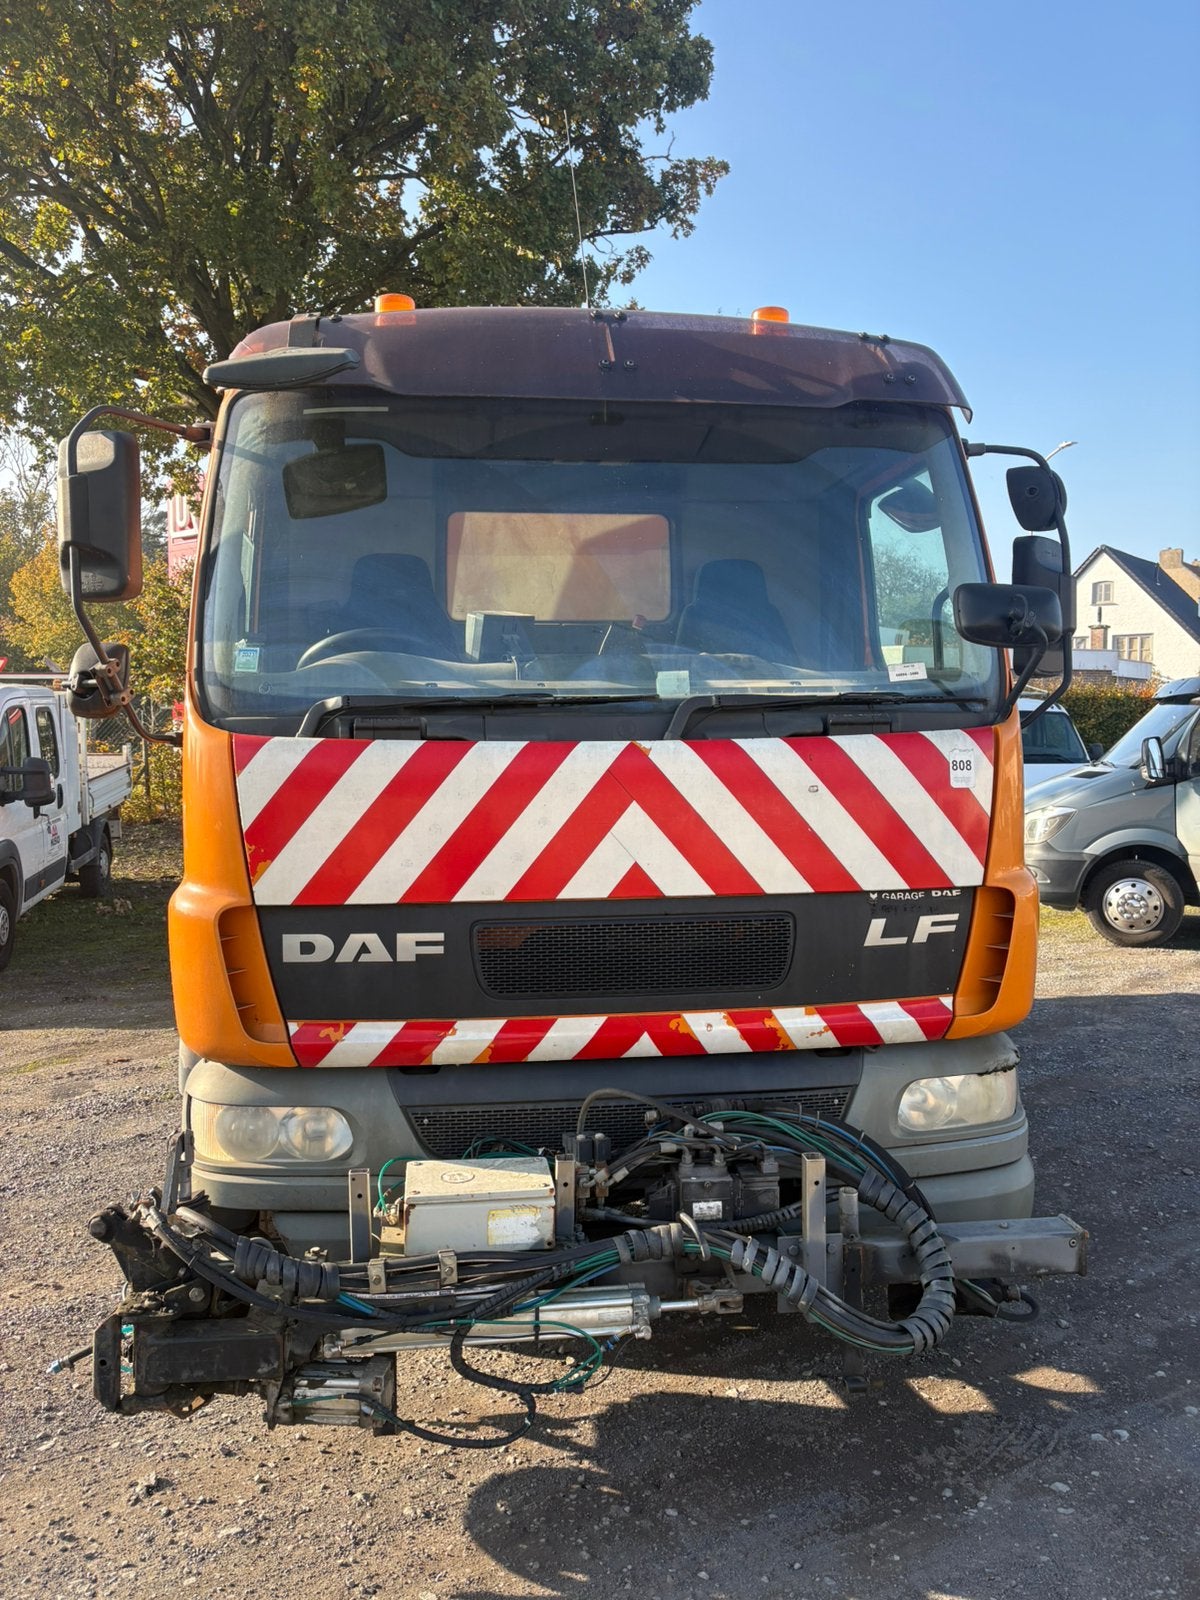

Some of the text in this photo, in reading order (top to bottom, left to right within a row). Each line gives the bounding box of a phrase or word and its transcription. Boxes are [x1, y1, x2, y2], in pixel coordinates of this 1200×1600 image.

[951, 759, 972, 771] 808
[863, 912, 960, 947] LF
[281, 932, 445, 963] DAF
